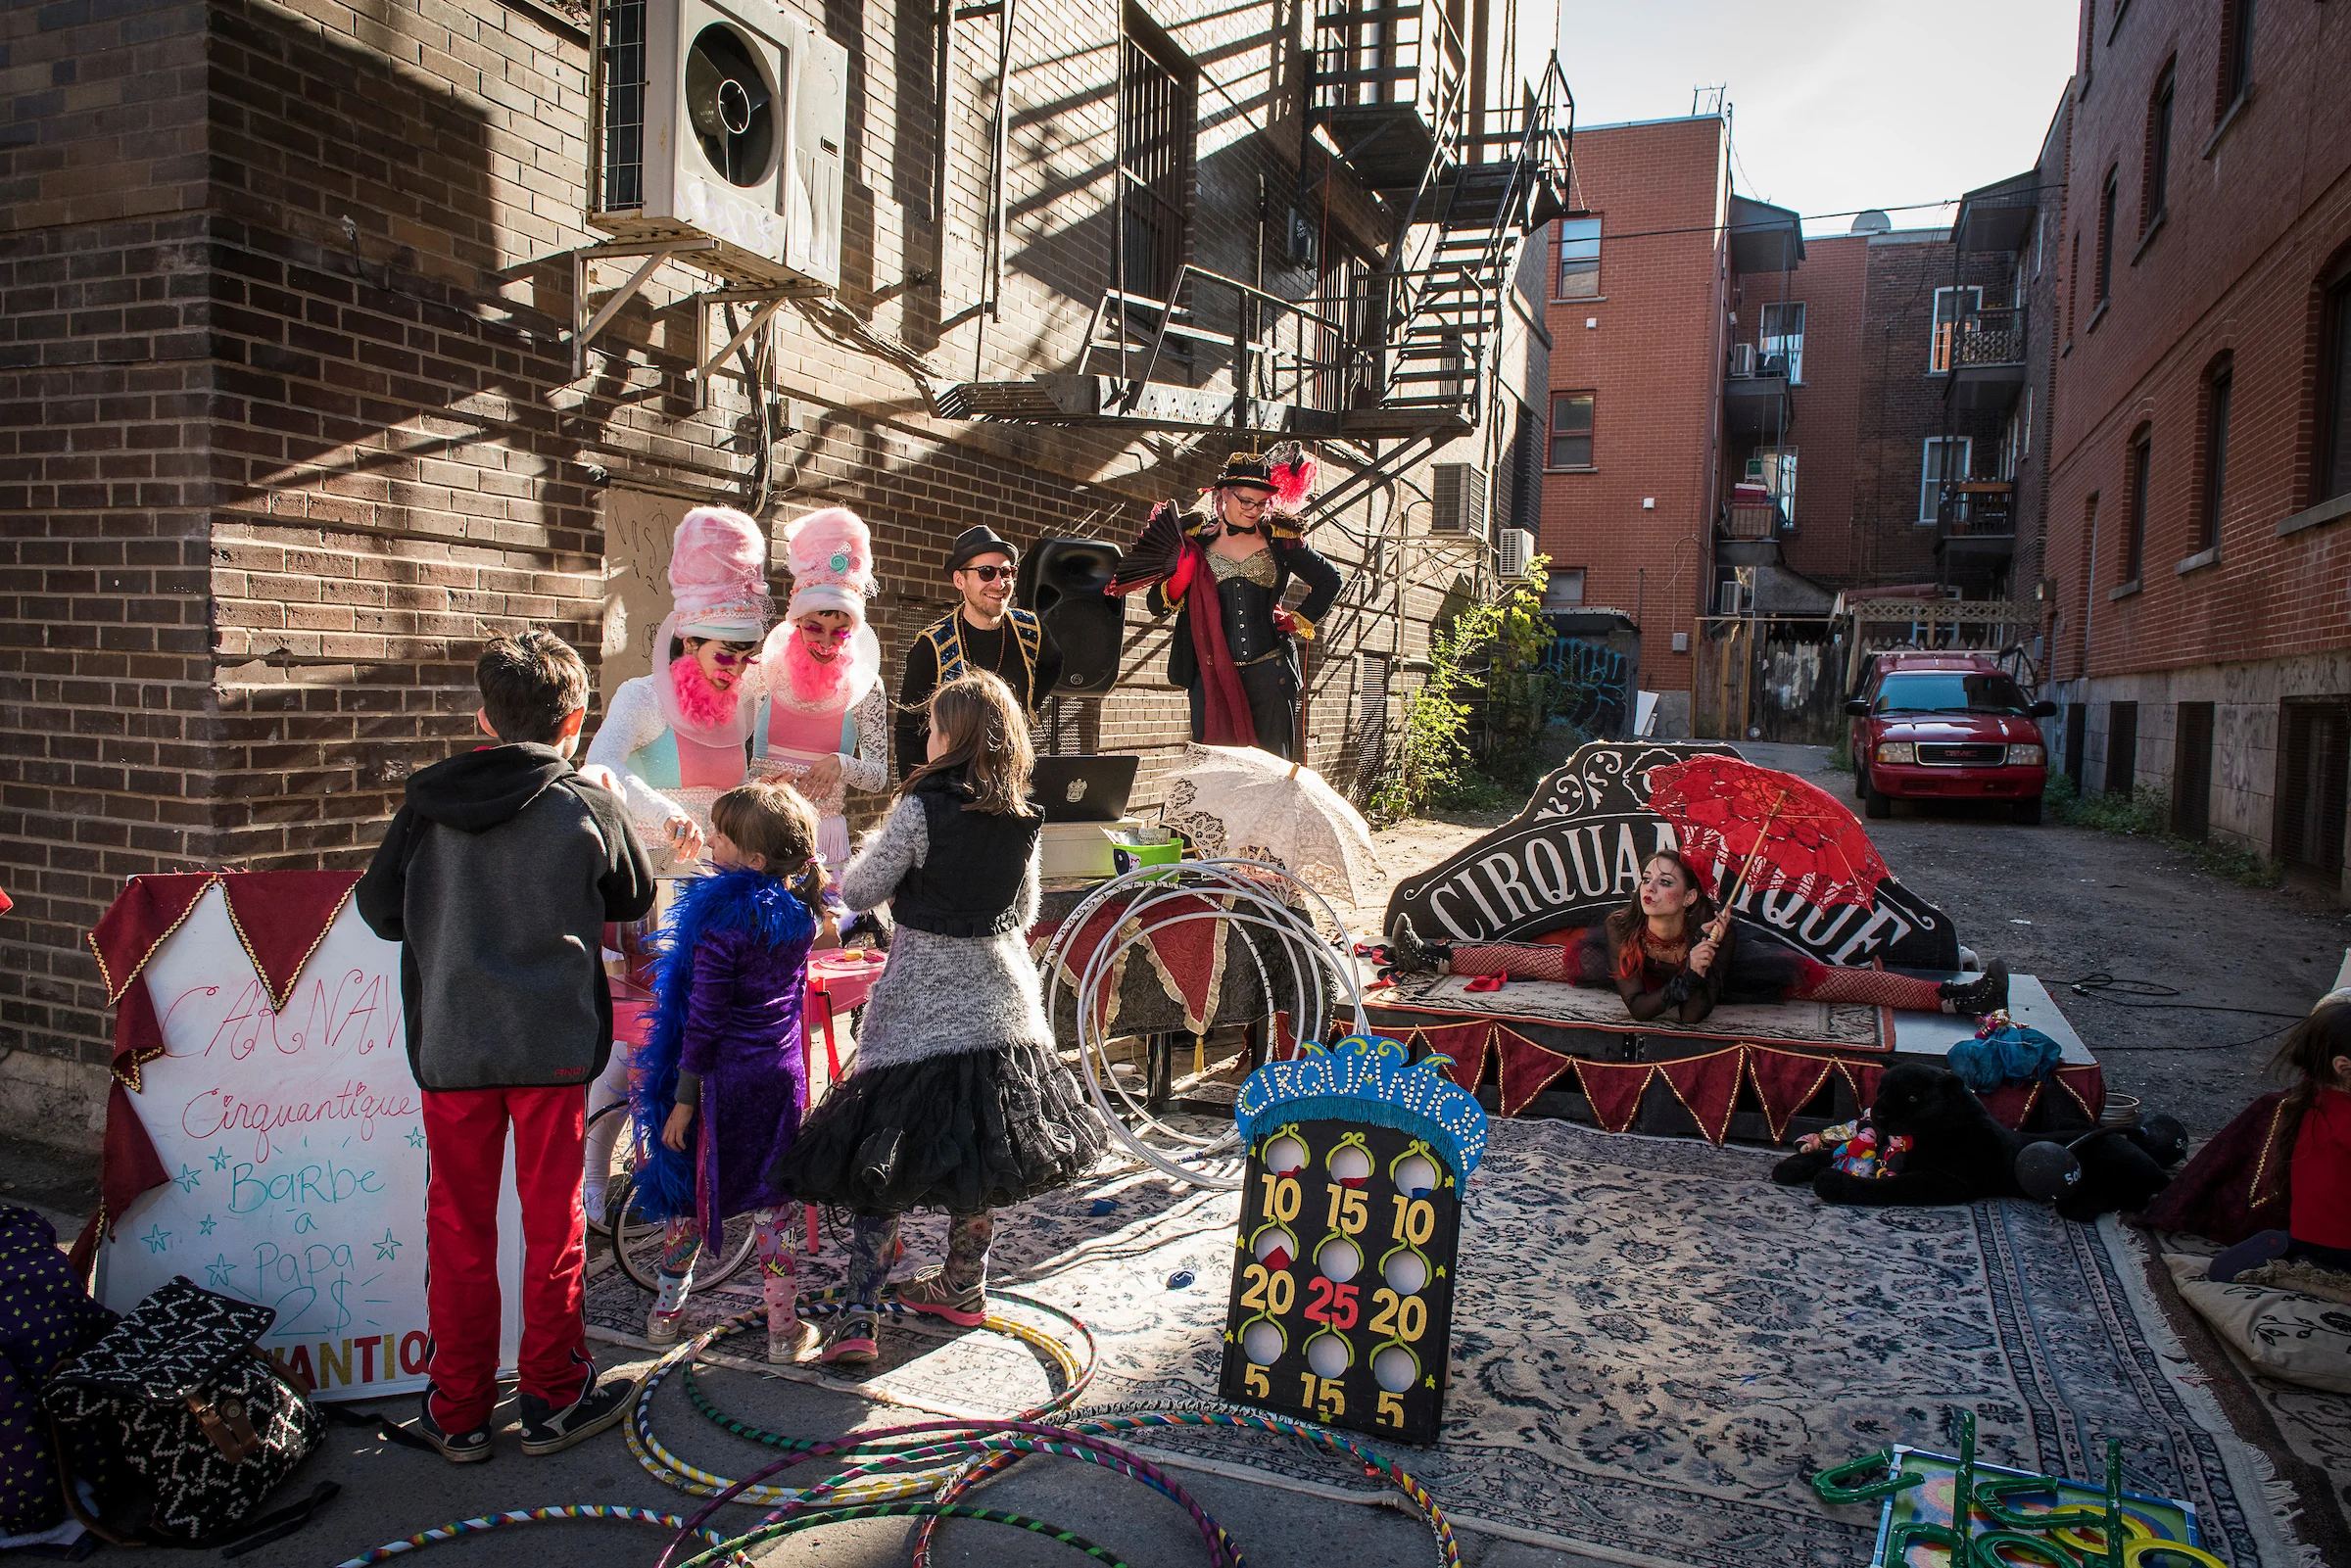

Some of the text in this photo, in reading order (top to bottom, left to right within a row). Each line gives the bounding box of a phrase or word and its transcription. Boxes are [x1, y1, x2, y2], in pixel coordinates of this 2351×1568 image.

[182, 1079, 421, 1163] Cirquantique
[1236, 1049, 1486, 1171] CIRQUANTIQUE
[1261, 1174, 1435, 1245] 10 15 10
[253, 1242, 355, 1299] Papa
[1240, 1263, 1427, 1343] 20 25 20
[1244, 1363, 1405, 1428] 5 15 5
